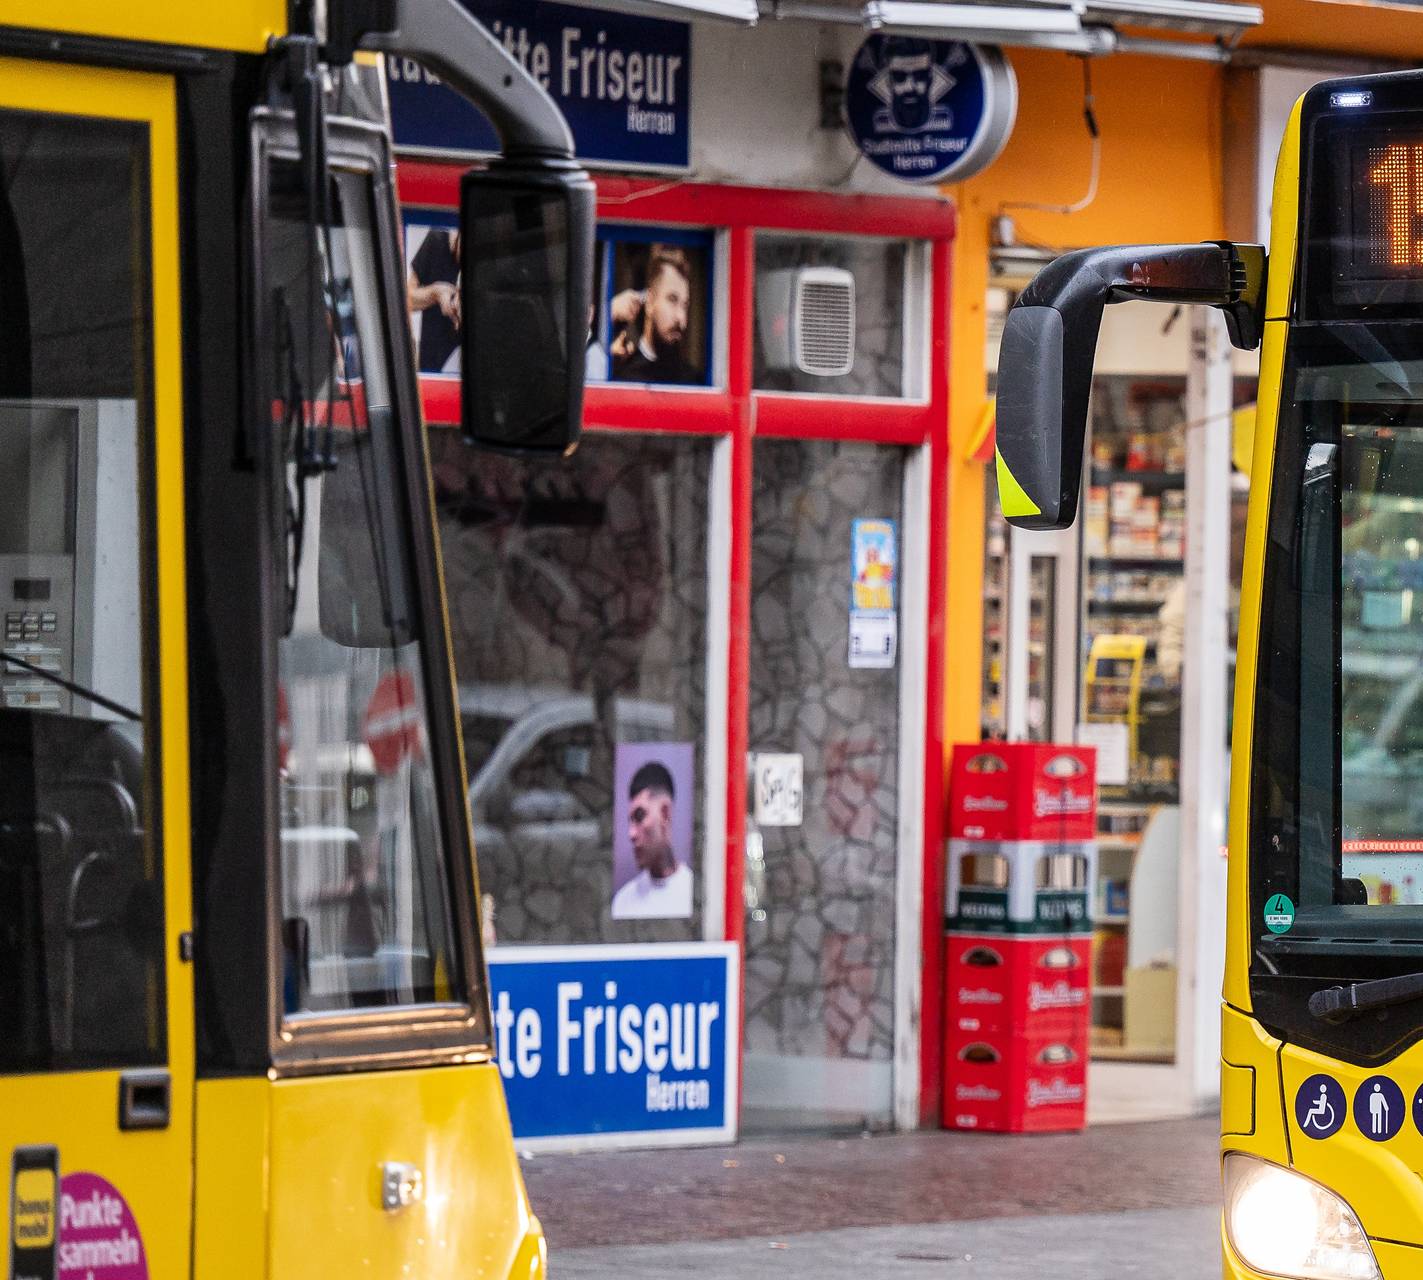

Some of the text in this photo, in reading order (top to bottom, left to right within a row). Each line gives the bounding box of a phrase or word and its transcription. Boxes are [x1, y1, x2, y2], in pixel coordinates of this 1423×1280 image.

[562, 26, 682, 104] Friseur
[626, 104, 676, 135] Herren
[1274, 895, 1285, 914] 4
[557, 980, 720, 1077] Friseur
[646, 1073, 710, 1112] Herren
[61, 1190, 122, 1230] Punkte
[60, 1228, 139, 1270] sammeln
